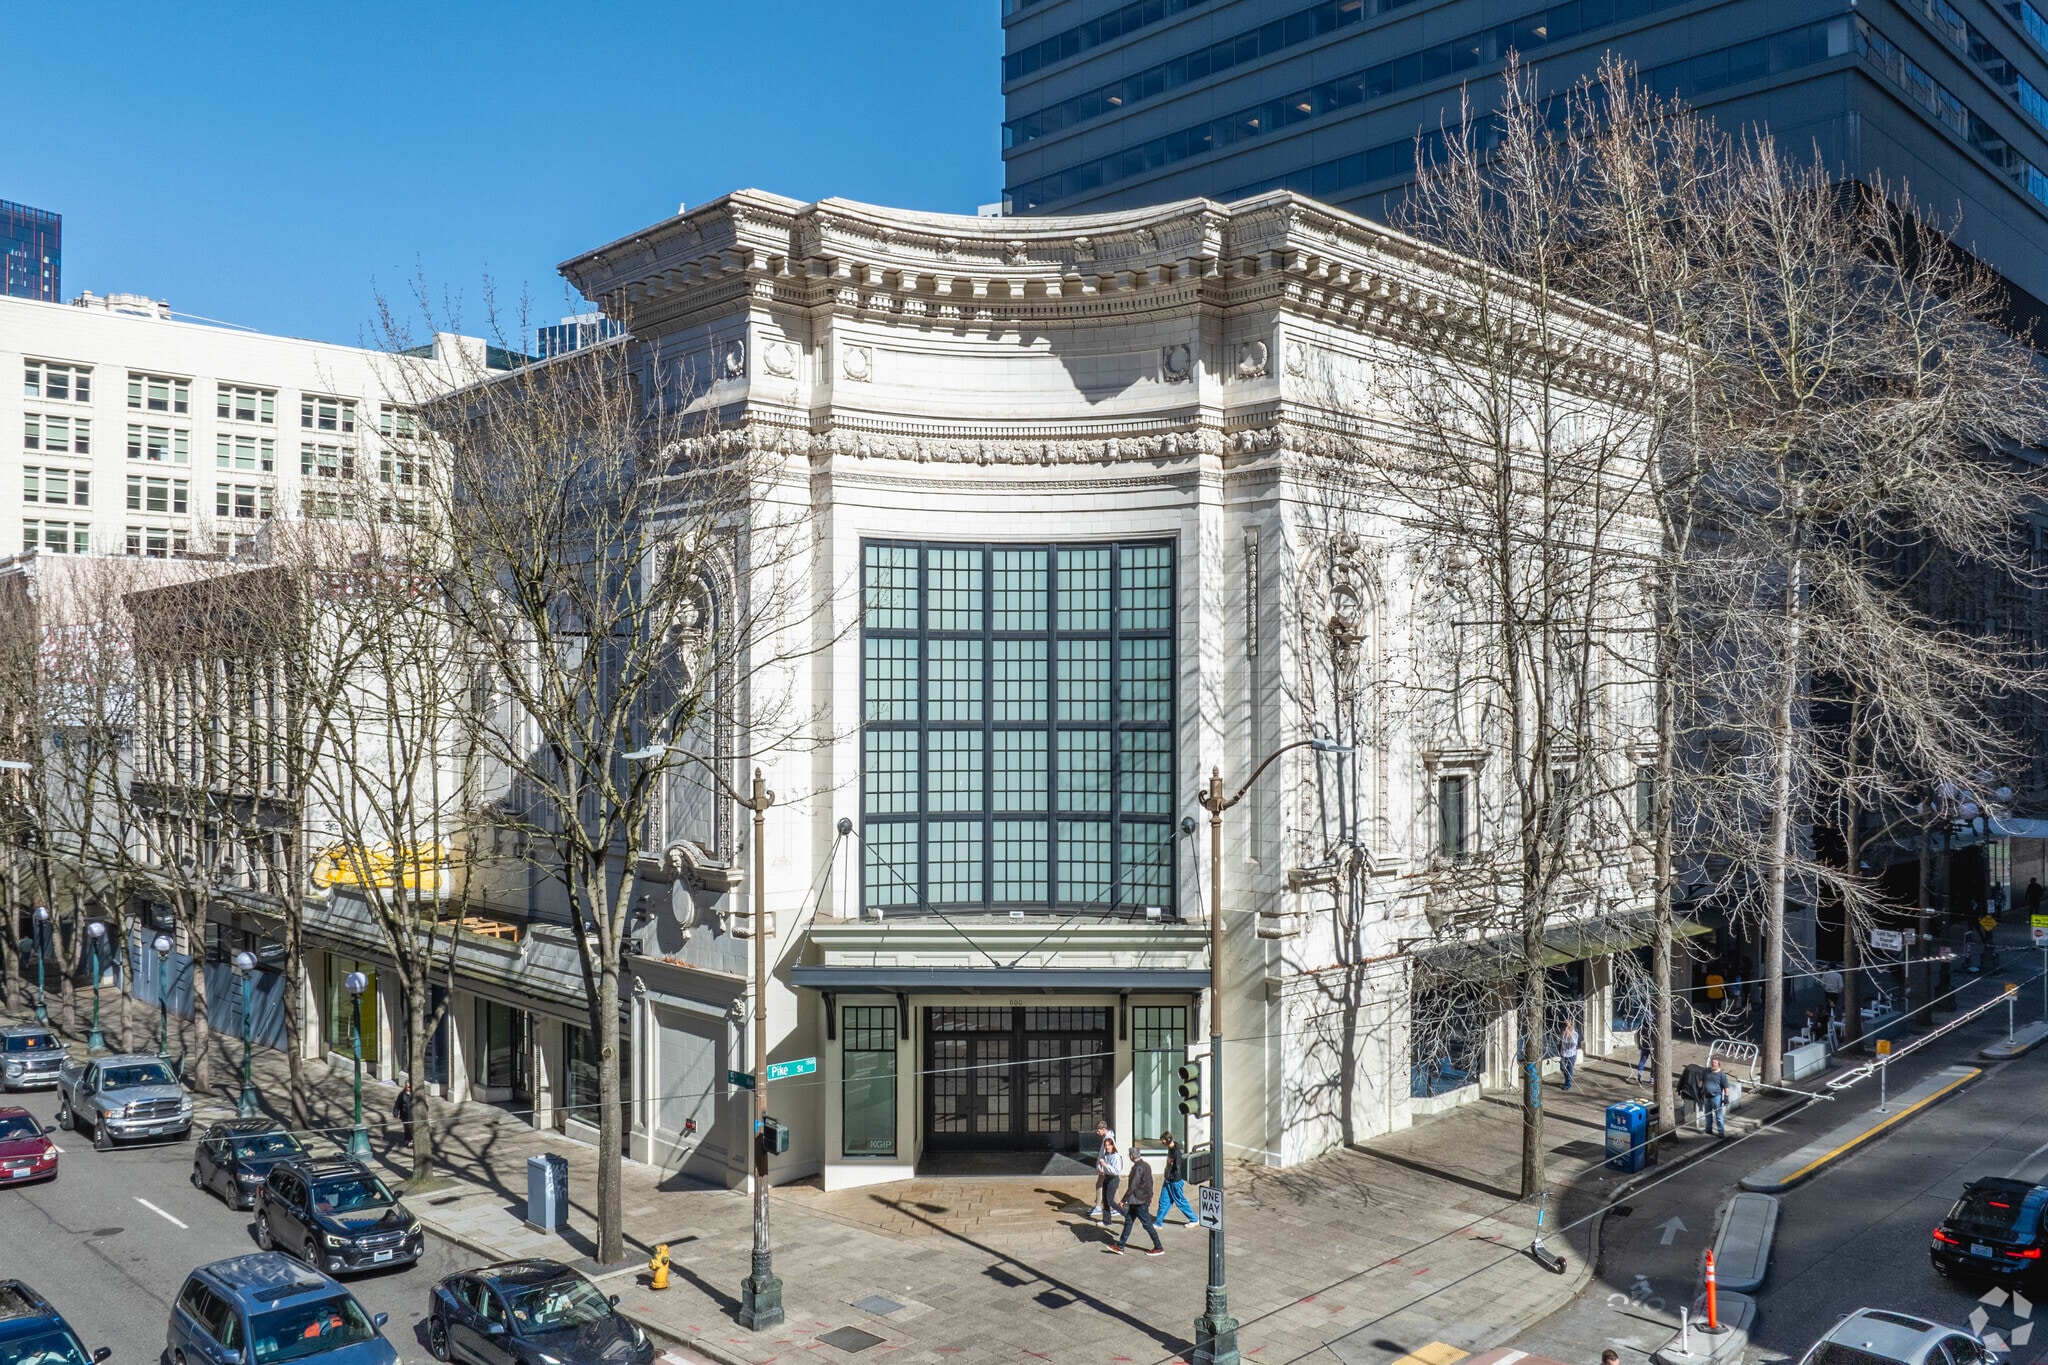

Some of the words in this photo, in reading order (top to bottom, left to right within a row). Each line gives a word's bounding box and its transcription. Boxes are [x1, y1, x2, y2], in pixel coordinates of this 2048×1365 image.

[771, 1066, 788, 1077] Pike
[797, 1065, 804, 1073] St
[1610, 1123, 1628, 1131] Recycle
[870, 1140, 892, 1148] KGIP
[1202, 1190, 1220, 1203] ONE
[1201, 1201, 1220, 1214] WAY
